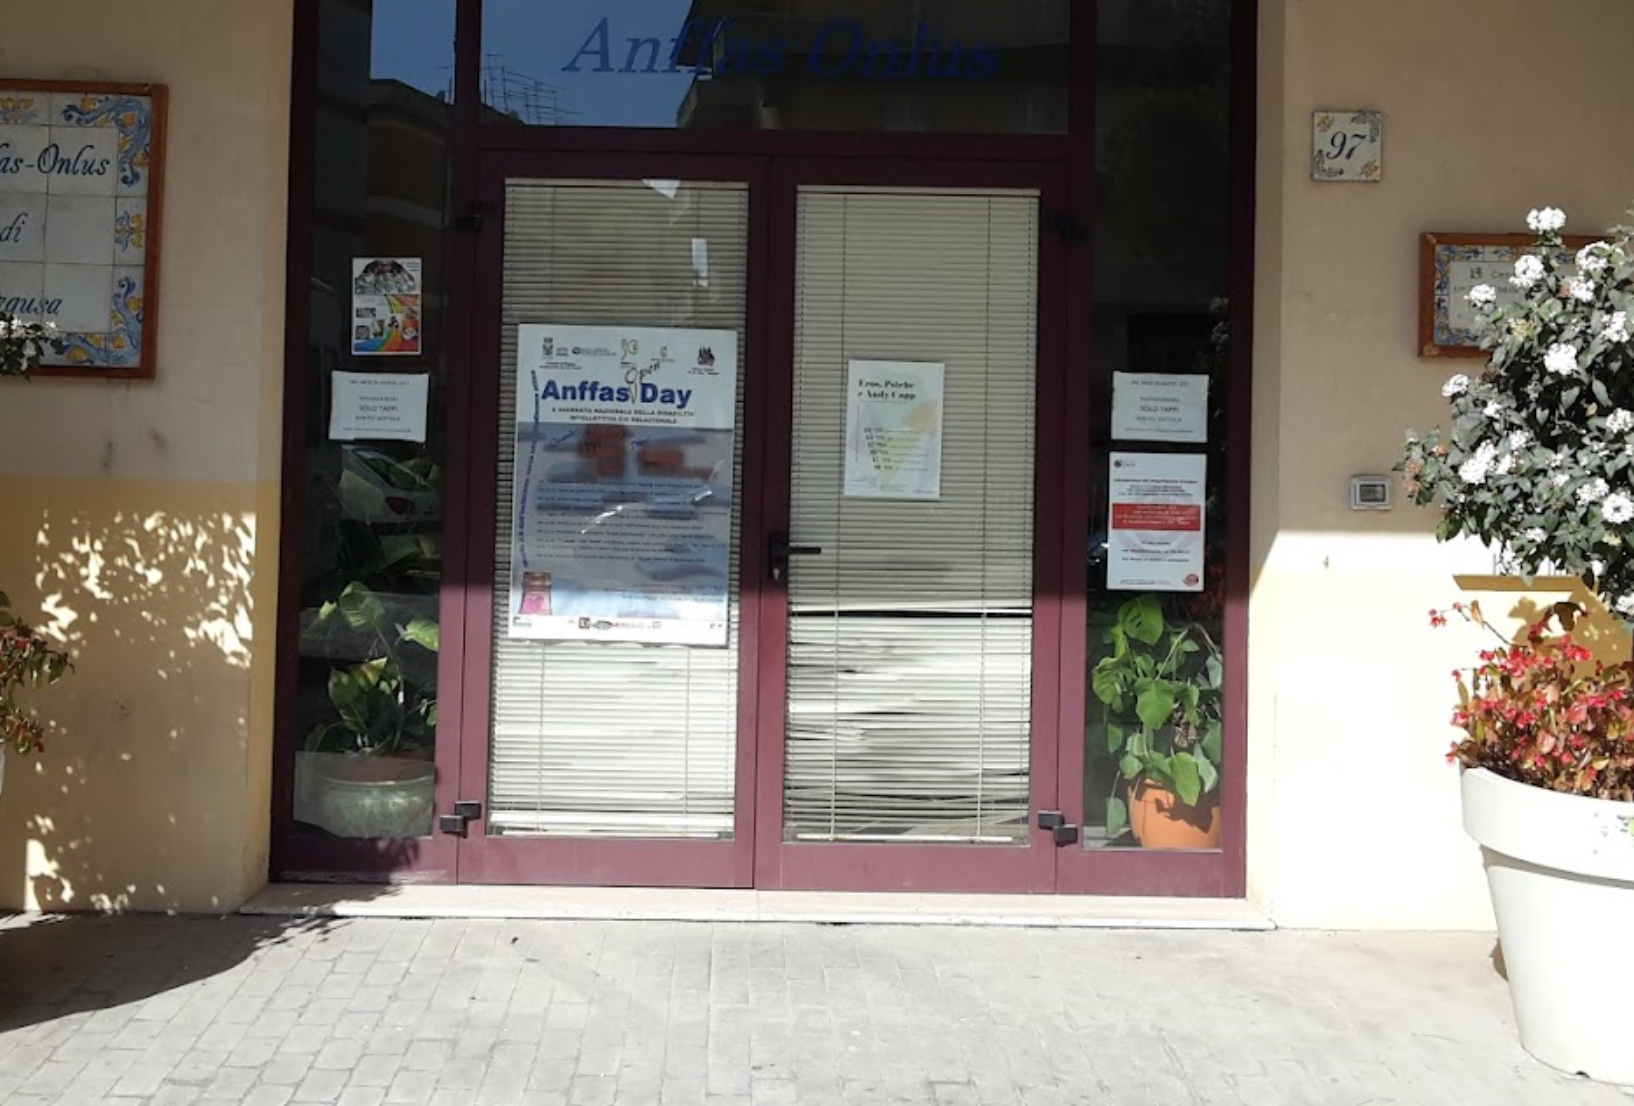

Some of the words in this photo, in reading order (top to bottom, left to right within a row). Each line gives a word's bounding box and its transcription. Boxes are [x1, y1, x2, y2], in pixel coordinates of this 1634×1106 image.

[562, 16, 791, 75] Anffas
[806, 17, 1001, 78] Onlus
[1326, 131, 1367, 161] 97
[358, 404, 377, 412] SOLO
[542, 379, 630, 402] Anffas
[640, 382, 692, 409] Day
